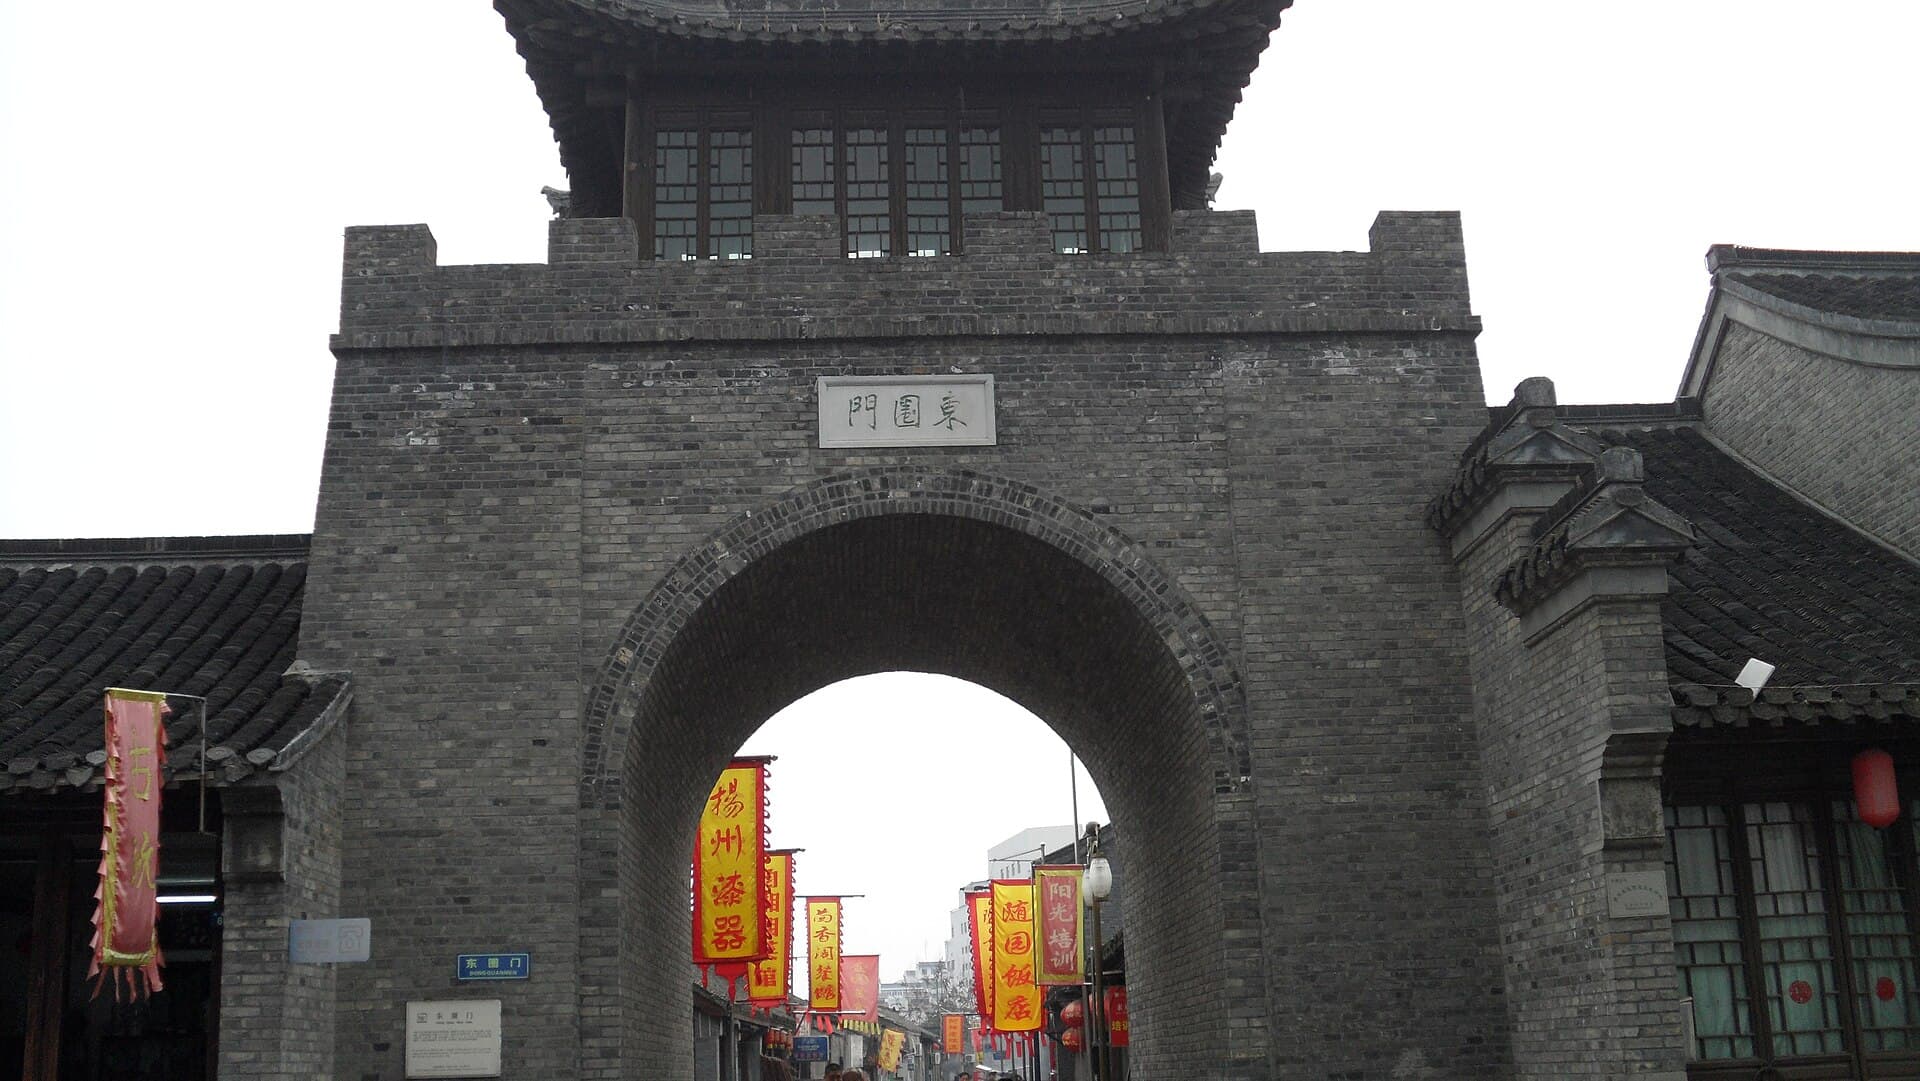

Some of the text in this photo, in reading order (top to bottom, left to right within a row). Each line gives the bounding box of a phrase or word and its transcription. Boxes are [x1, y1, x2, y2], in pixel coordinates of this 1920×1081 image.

[1002, 900, 1034, 1021] 随园饭店
[1047, 882, 1075, 972] 阳光培训
